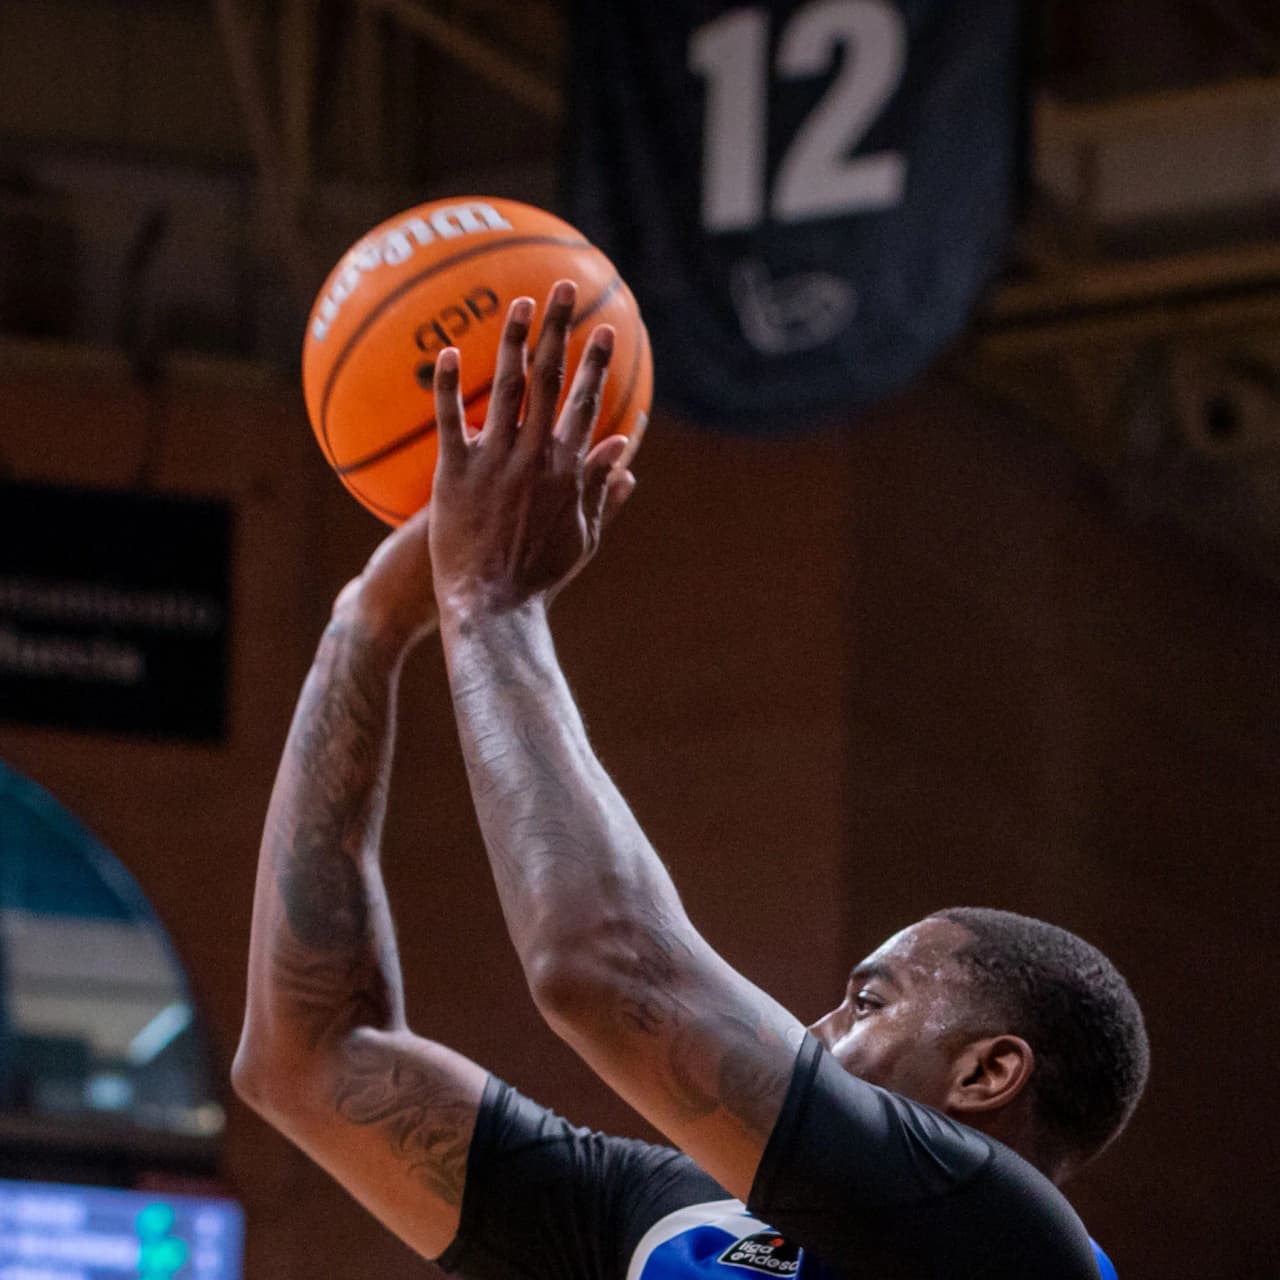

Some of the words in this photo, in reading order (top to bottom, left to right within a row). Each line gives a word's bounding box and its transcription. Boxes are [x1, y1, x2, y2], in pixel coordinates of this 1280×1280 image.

[687, 0, 908, 233] 12
[311, 200, 514, 342] Wilson
[414, 285, 499, 352] acb
